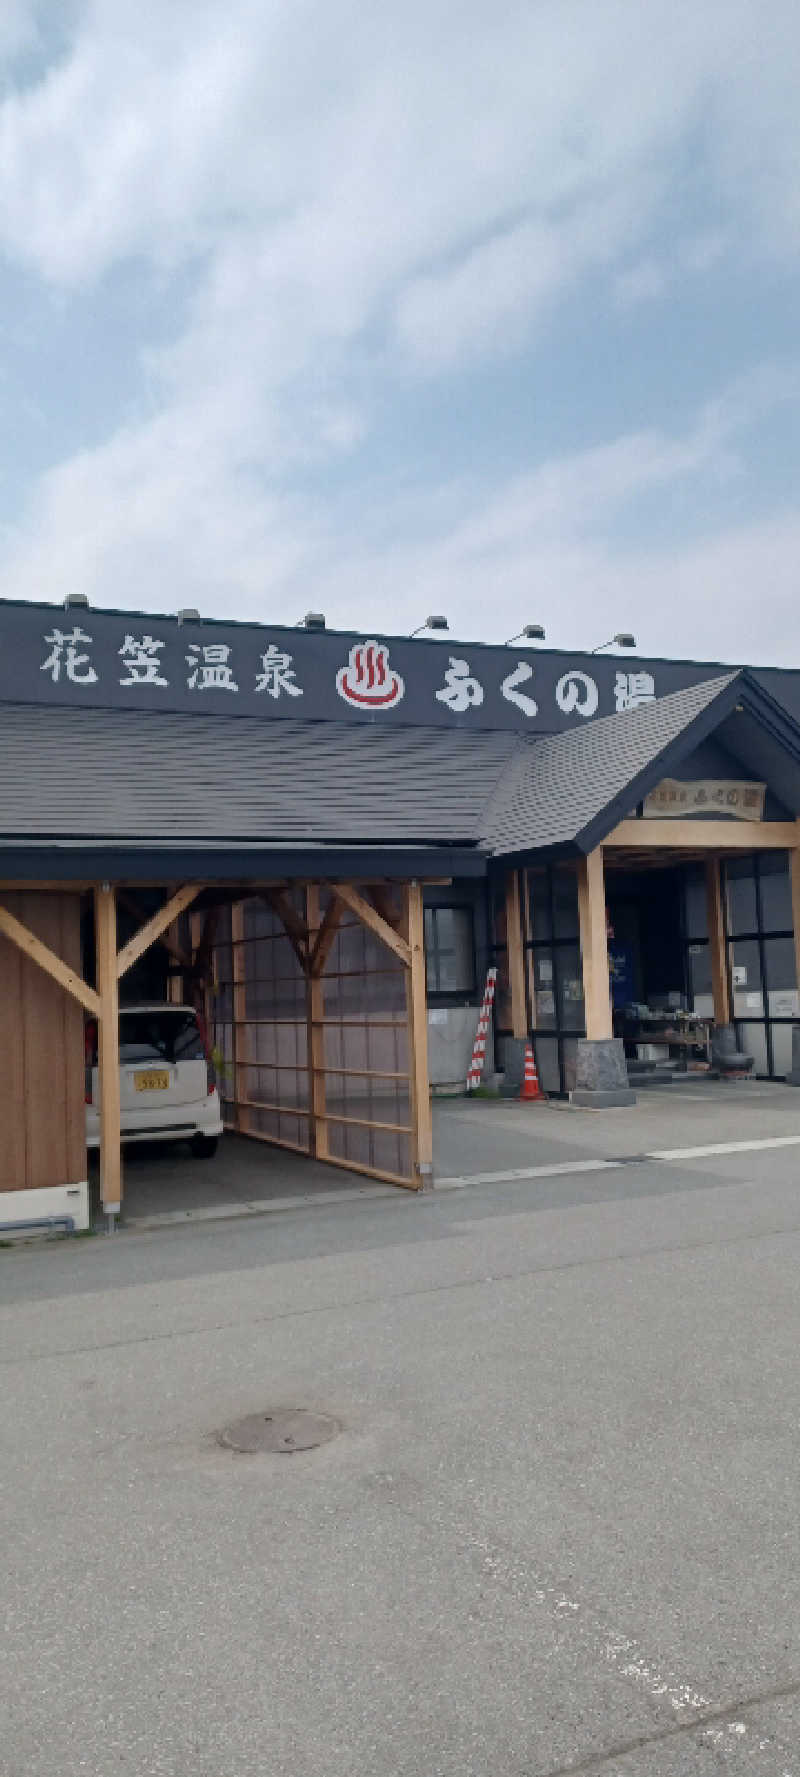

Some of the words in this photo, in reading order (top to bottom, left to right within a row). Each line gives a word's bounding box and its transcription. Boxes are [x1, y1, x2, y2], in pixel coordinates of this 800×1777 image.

[40, 627, 304, 699] 花笠温泉
[435, 656, 656, 717] ふくの湯
